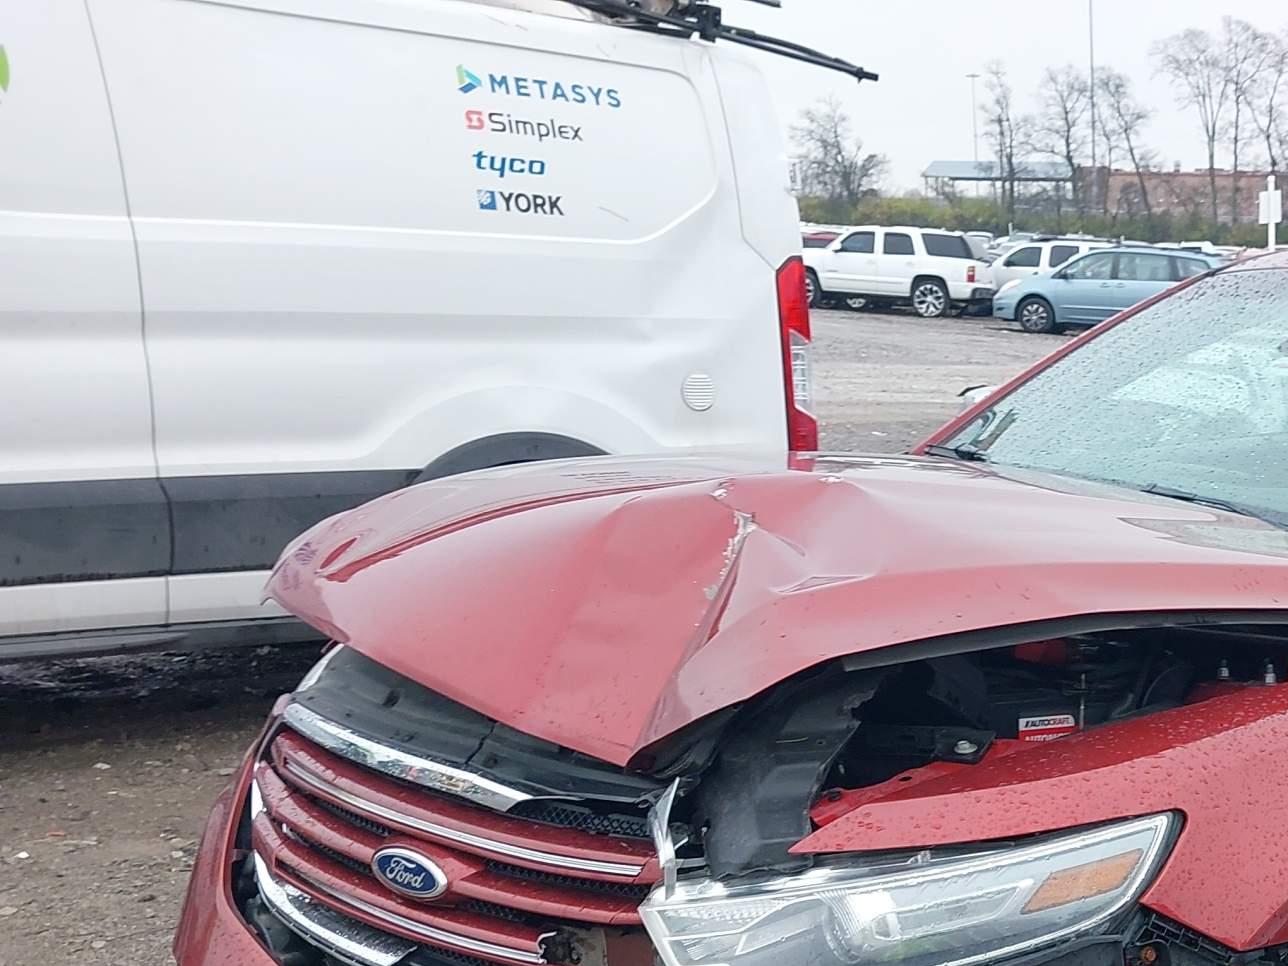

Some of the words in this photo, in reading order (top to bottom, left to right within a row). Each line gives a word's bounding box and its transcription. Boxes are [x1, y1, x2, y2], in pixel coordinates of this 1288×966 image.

[488, 73, 622, 109] METASYS
[487, 111, 583, 142] Simplex
[471, 149, 547, 179] tyco
[498, 190, 566, 217] YORK
[385, 857, 427, 889] Ford
